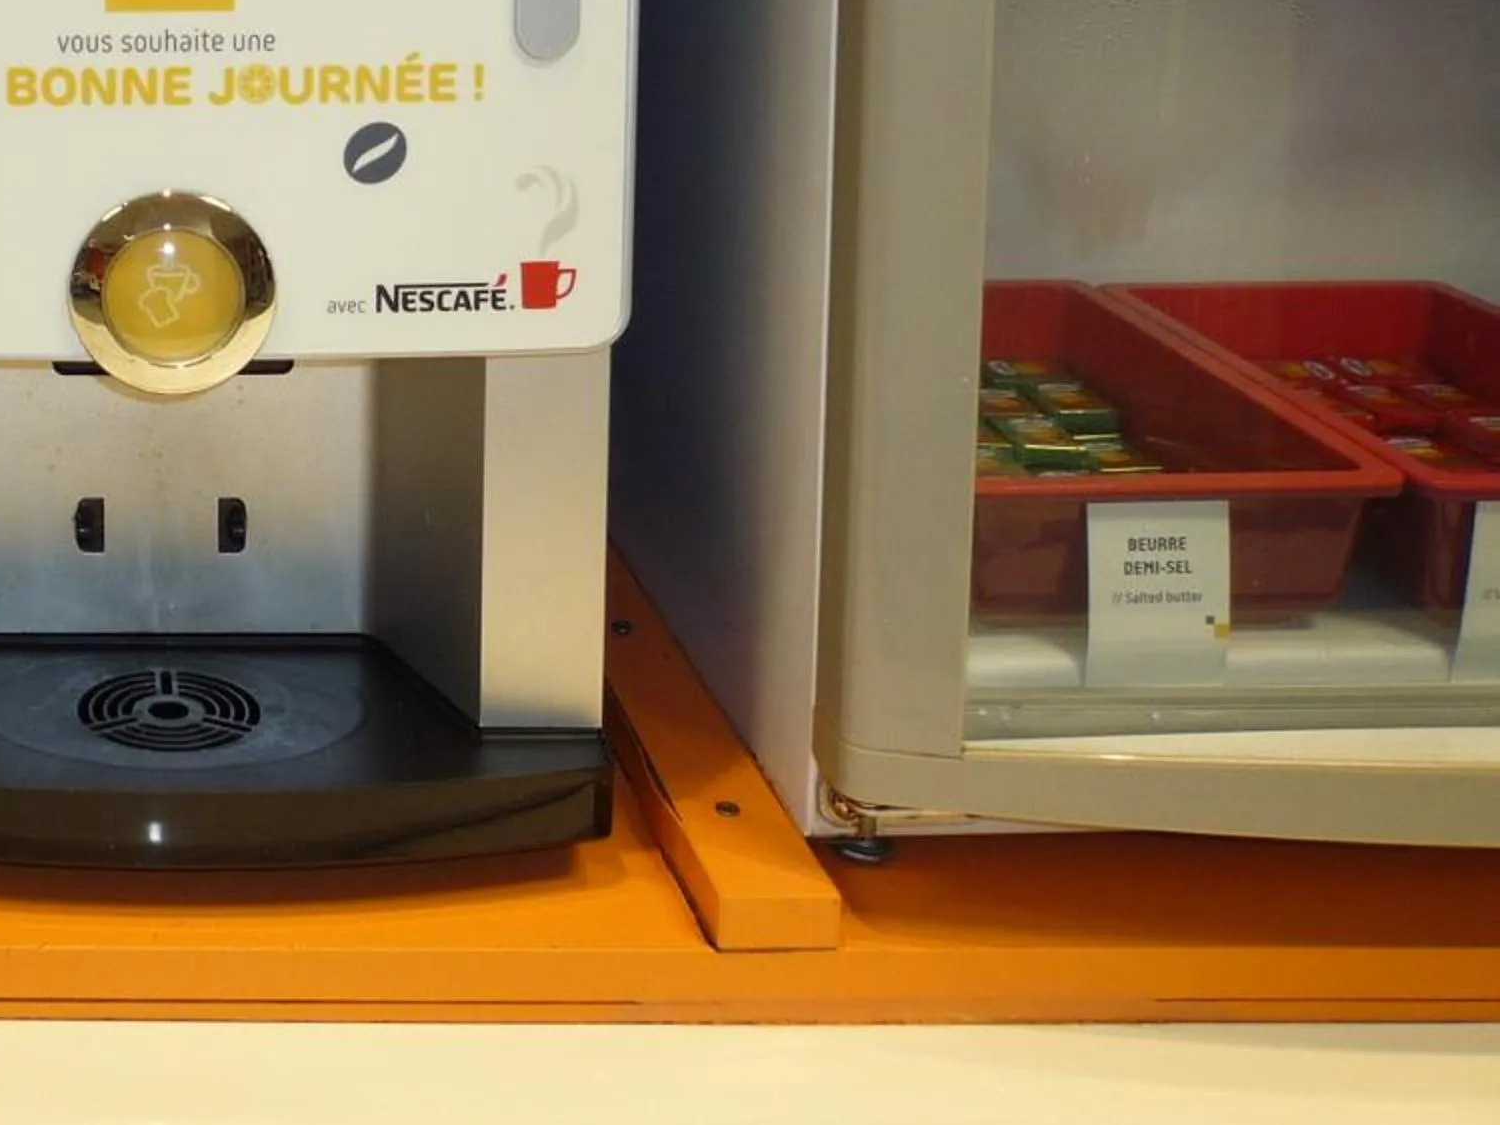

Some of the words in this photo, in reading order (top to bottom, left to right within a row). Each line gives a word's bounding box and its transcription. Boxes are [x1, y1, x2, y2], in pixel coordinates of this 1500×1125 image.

[57, 34, 113, 54] vous
[121, 29, 225, 53] souhaite
[233, 34, 276, 52] une
[6, 65, 193, 106] BONNE
[208, 52, 458, 106] JOURNÉE
[327, 299, 367, 314] avec
[1127, 536, 1188, 552] BEURRE
[1123, 560, 1193, 576] DEMI-SEL
[1125, 591, 1163, 604] Salted
[1165, 591, 1203, 604] butter
